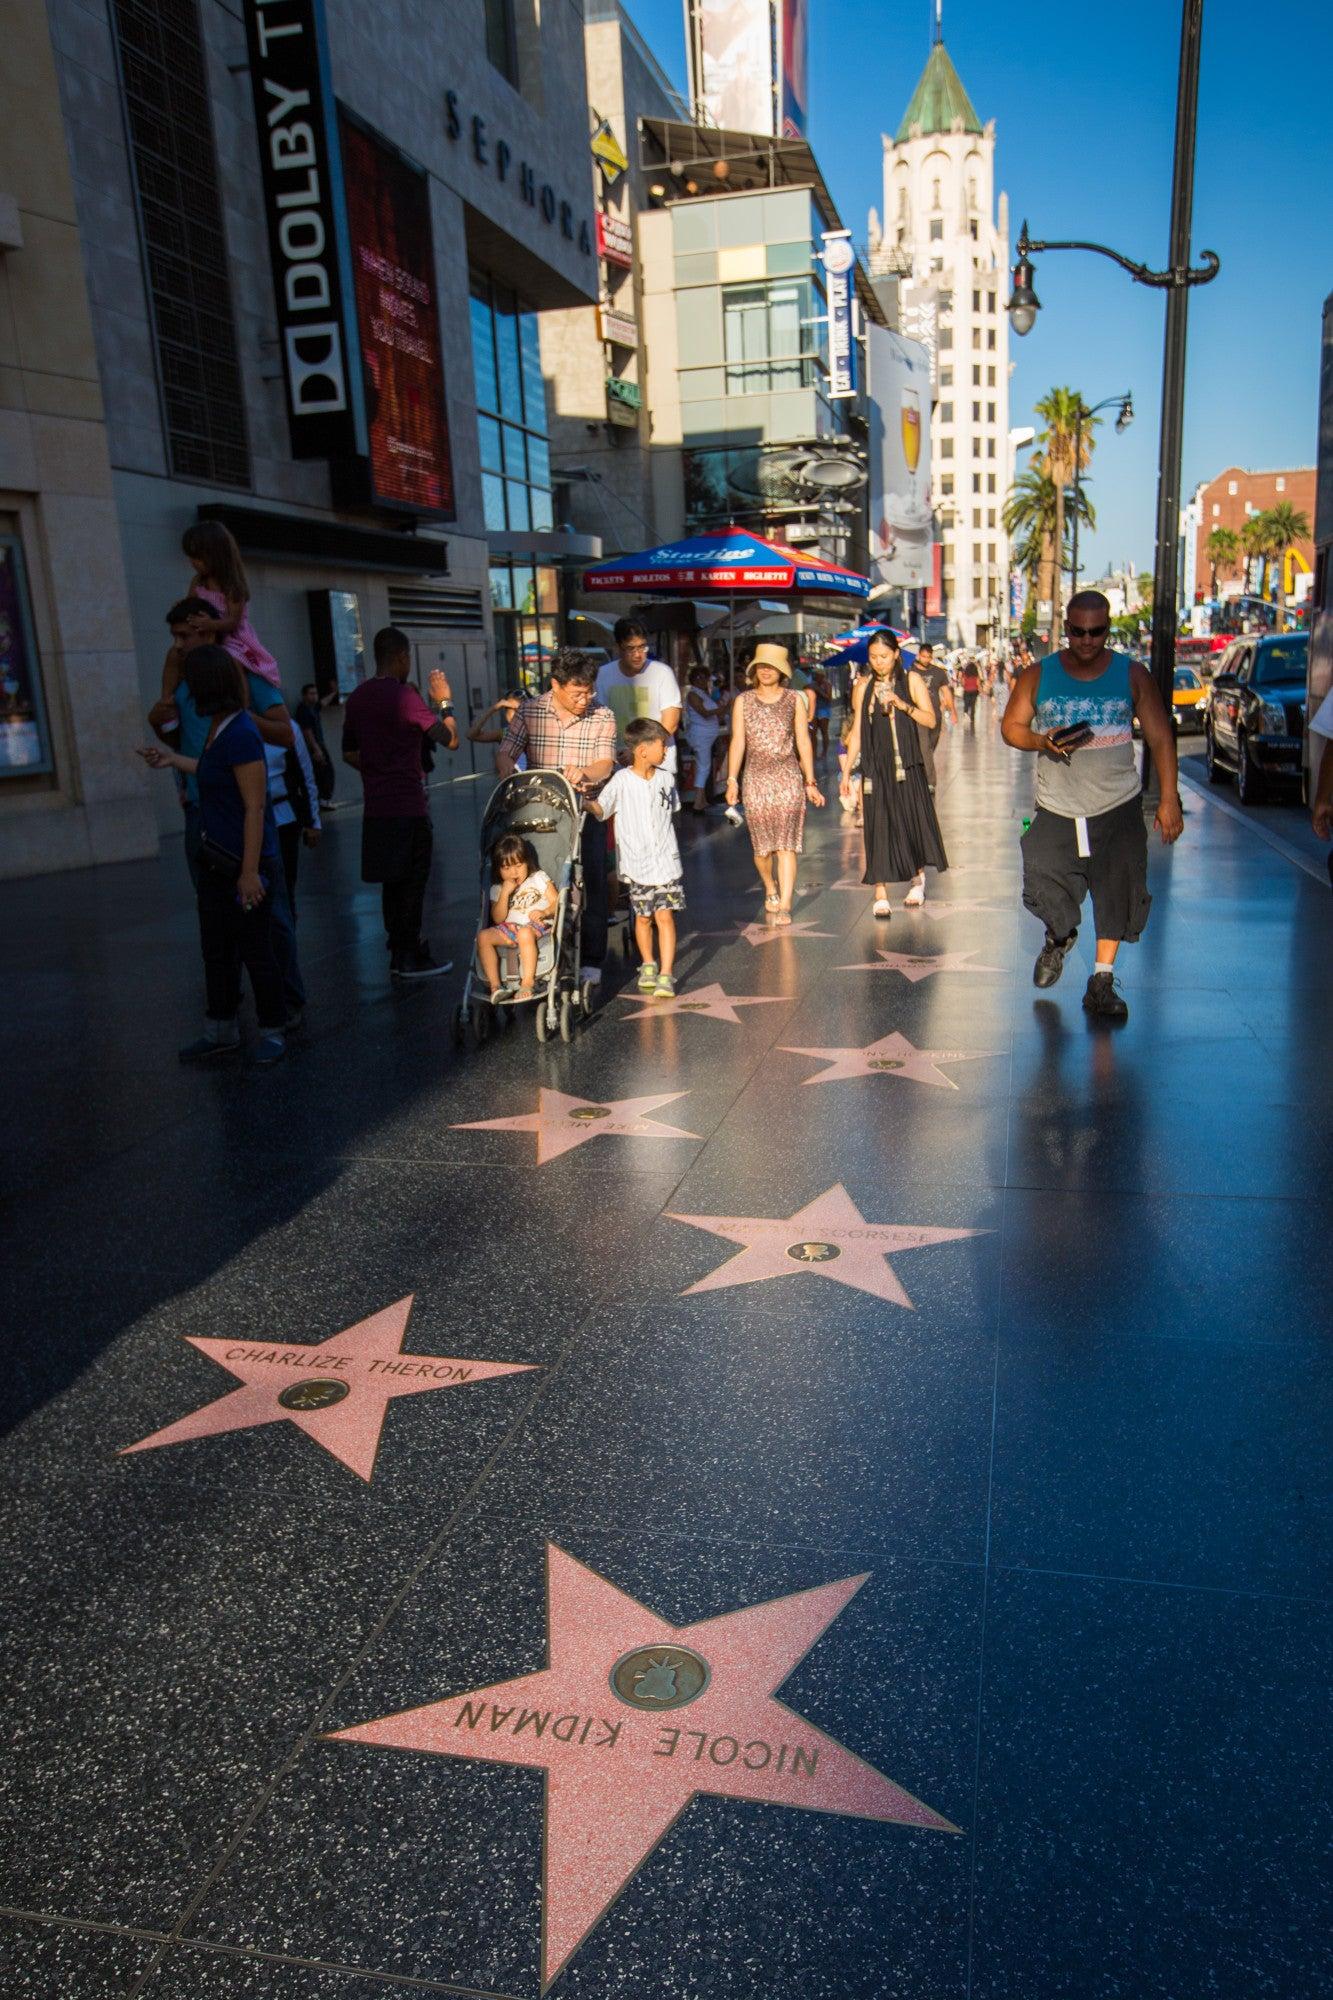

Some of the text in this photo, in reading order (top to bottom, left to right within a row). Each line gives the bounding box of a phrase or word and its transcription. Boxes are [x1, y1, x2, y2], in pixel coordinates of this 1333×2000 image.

[262, 78, 331, 311] DOLBY
[445, 89, 591, 257] SEPHORA
[701, 571, 737, 581] KARTEN
[225, 1347, 473, 1381] CHARLIZE THERON
[454, 1700, 820, 1777] NICOLE KIDMAN
